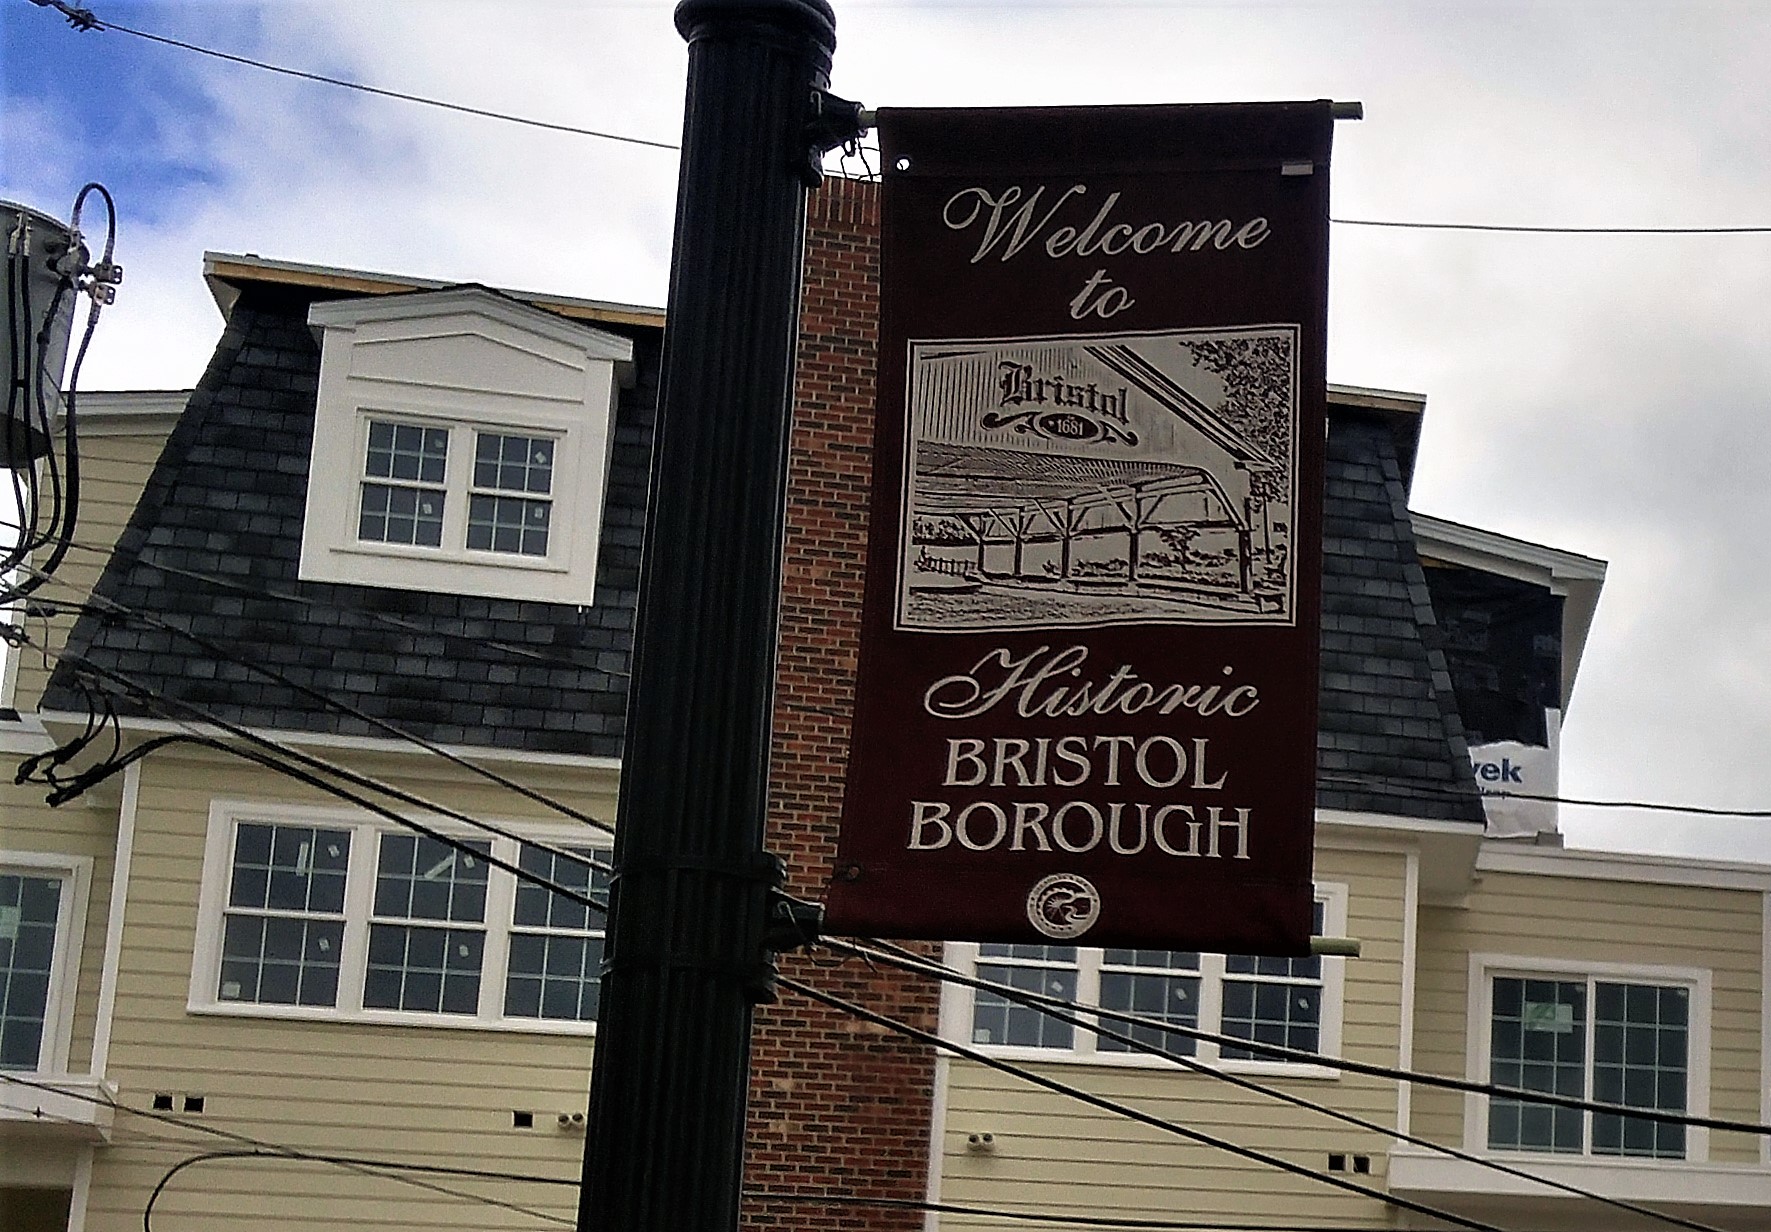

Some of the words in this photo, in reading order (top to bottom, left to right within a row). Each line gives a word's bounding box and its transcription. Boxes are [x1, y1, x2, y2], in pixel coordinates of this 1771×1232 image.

[943, 185, 1271, 263] Welcome
[1069, 267, 1135, 320] to
[999, 361, 1130, 425] Bristol
[1057, 418, 1084, 436] 1681
[924, 645, 1260, 719] Historic
[942, 734, 1227, 792] BRISTOL
[908, 800, 1253, 860] BOROUGH
